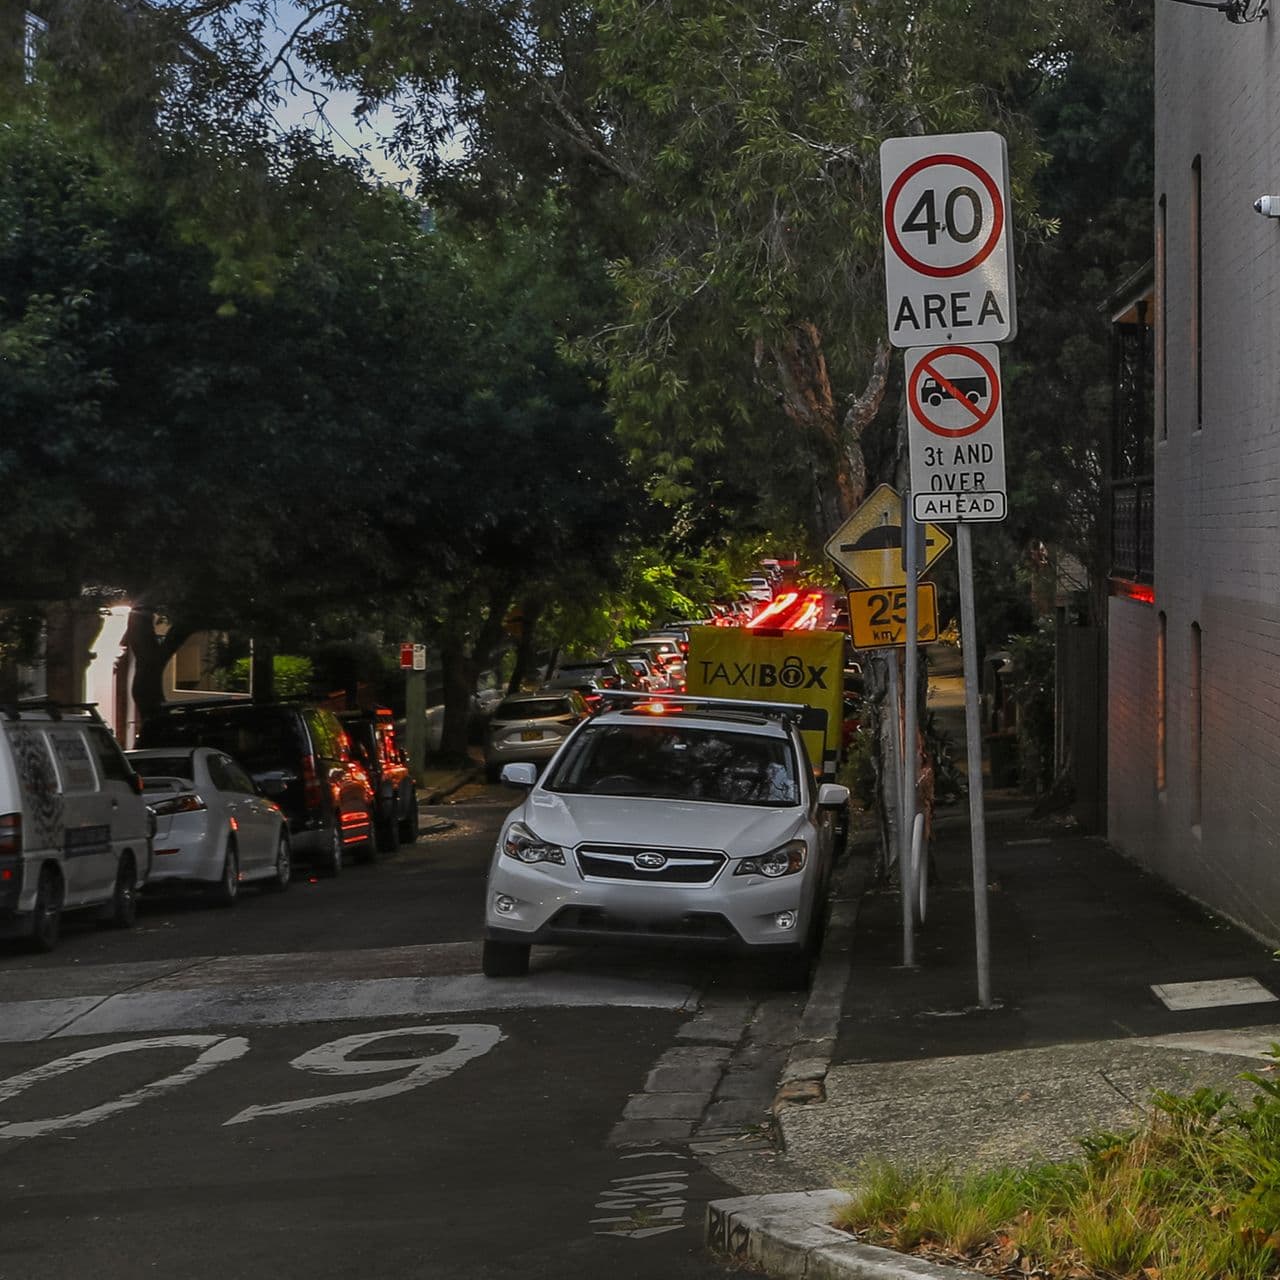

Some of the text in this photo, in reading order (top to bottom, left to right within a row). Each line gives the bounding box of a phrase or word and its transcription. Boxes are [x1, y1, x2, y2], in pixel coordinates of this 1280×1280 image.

[901, 186, 983, 245] 40
[894, 290, 1005, 332] AREA
[924, 444, 993, 466] 3t AND
[931, 472, 985, 491] OVER
[924, 499, 995, 514] AHEAD
